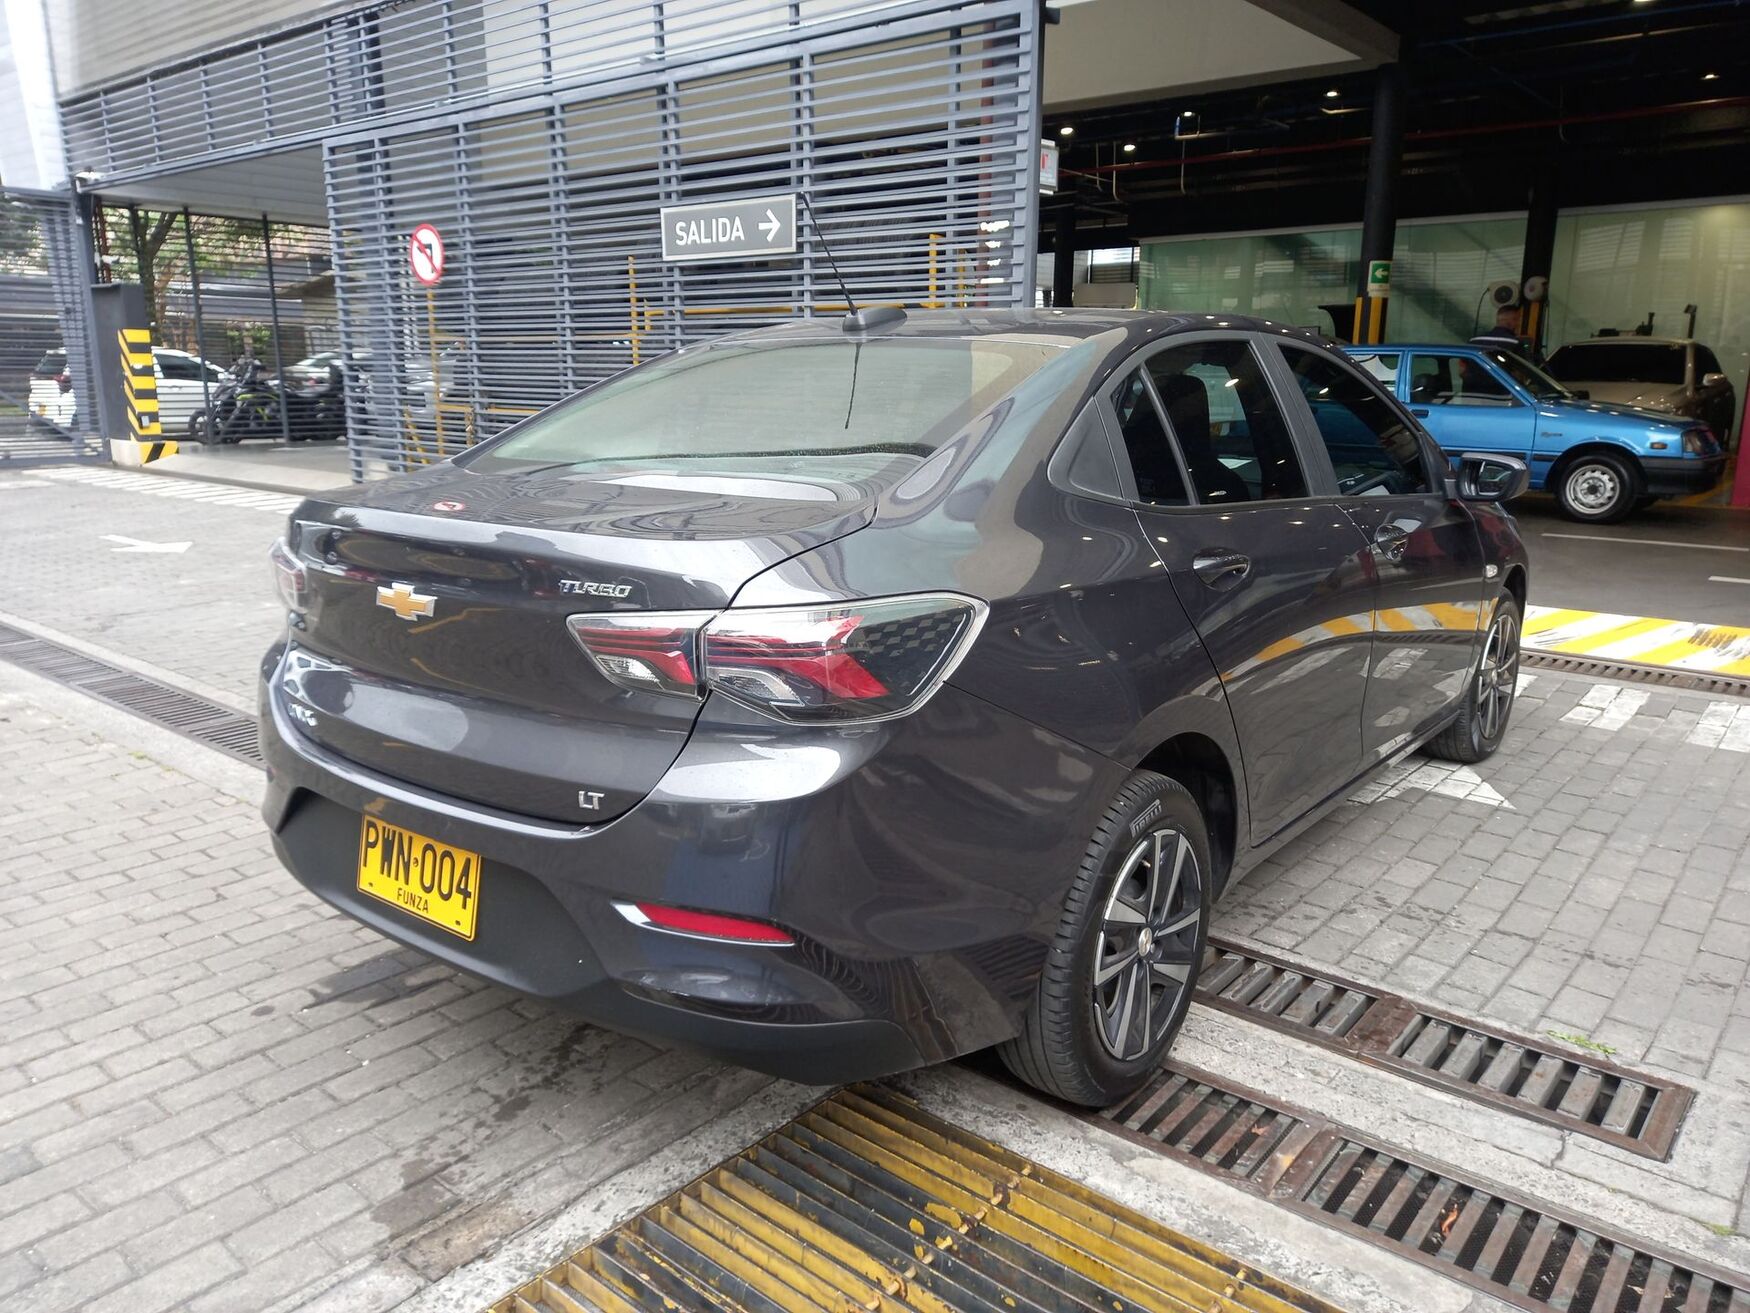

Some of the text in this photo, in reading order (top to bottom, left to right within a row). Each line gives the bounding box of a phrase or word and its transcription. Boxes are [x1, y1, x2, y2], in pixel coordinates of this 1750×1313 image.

[675, 216, 745, 246] SALIDA
[558, 579, 633, 598] TURBO
[578, 790, 605, 810] LT
[396, 887, 430, 914] FUNZA
